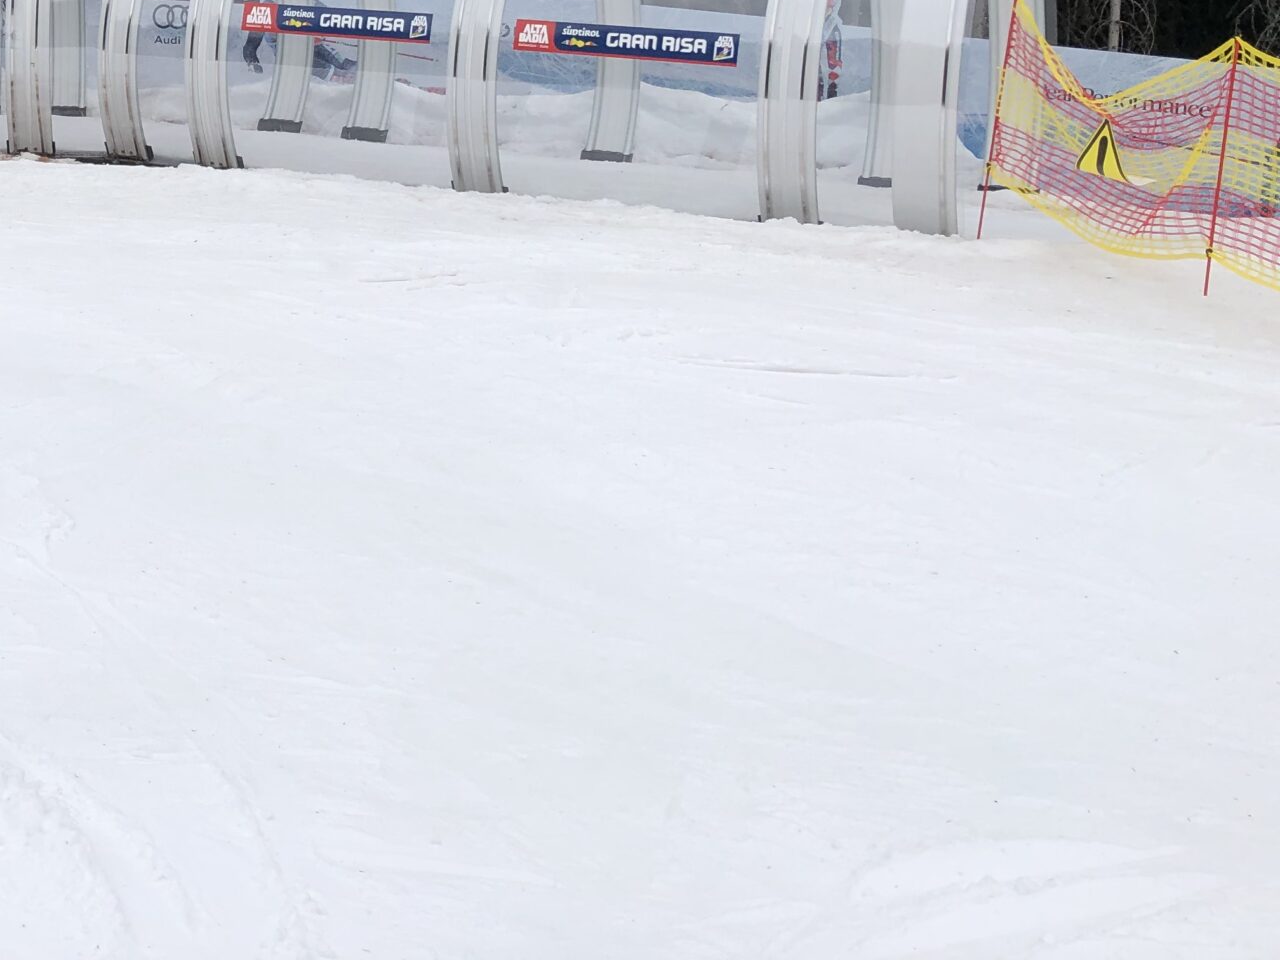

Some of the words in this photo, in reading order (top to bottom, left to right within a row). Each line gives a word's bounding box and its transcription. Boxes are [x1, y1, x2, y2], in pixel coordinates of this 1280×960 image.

[250, 6, 271, 16] ALTA
[246, 14, 272, 25] BADIA
[320, 13, 362, 30] GRAN
[366, 17, 405, 33] RISA
[523, 24, 548, 34] ALTA
[153, 35, 181, 45] Audi
[518, 32, 549, 44] BADIA
[606, 32, 658, 50] GRAN
[662, 36, 707, 54] RISA
